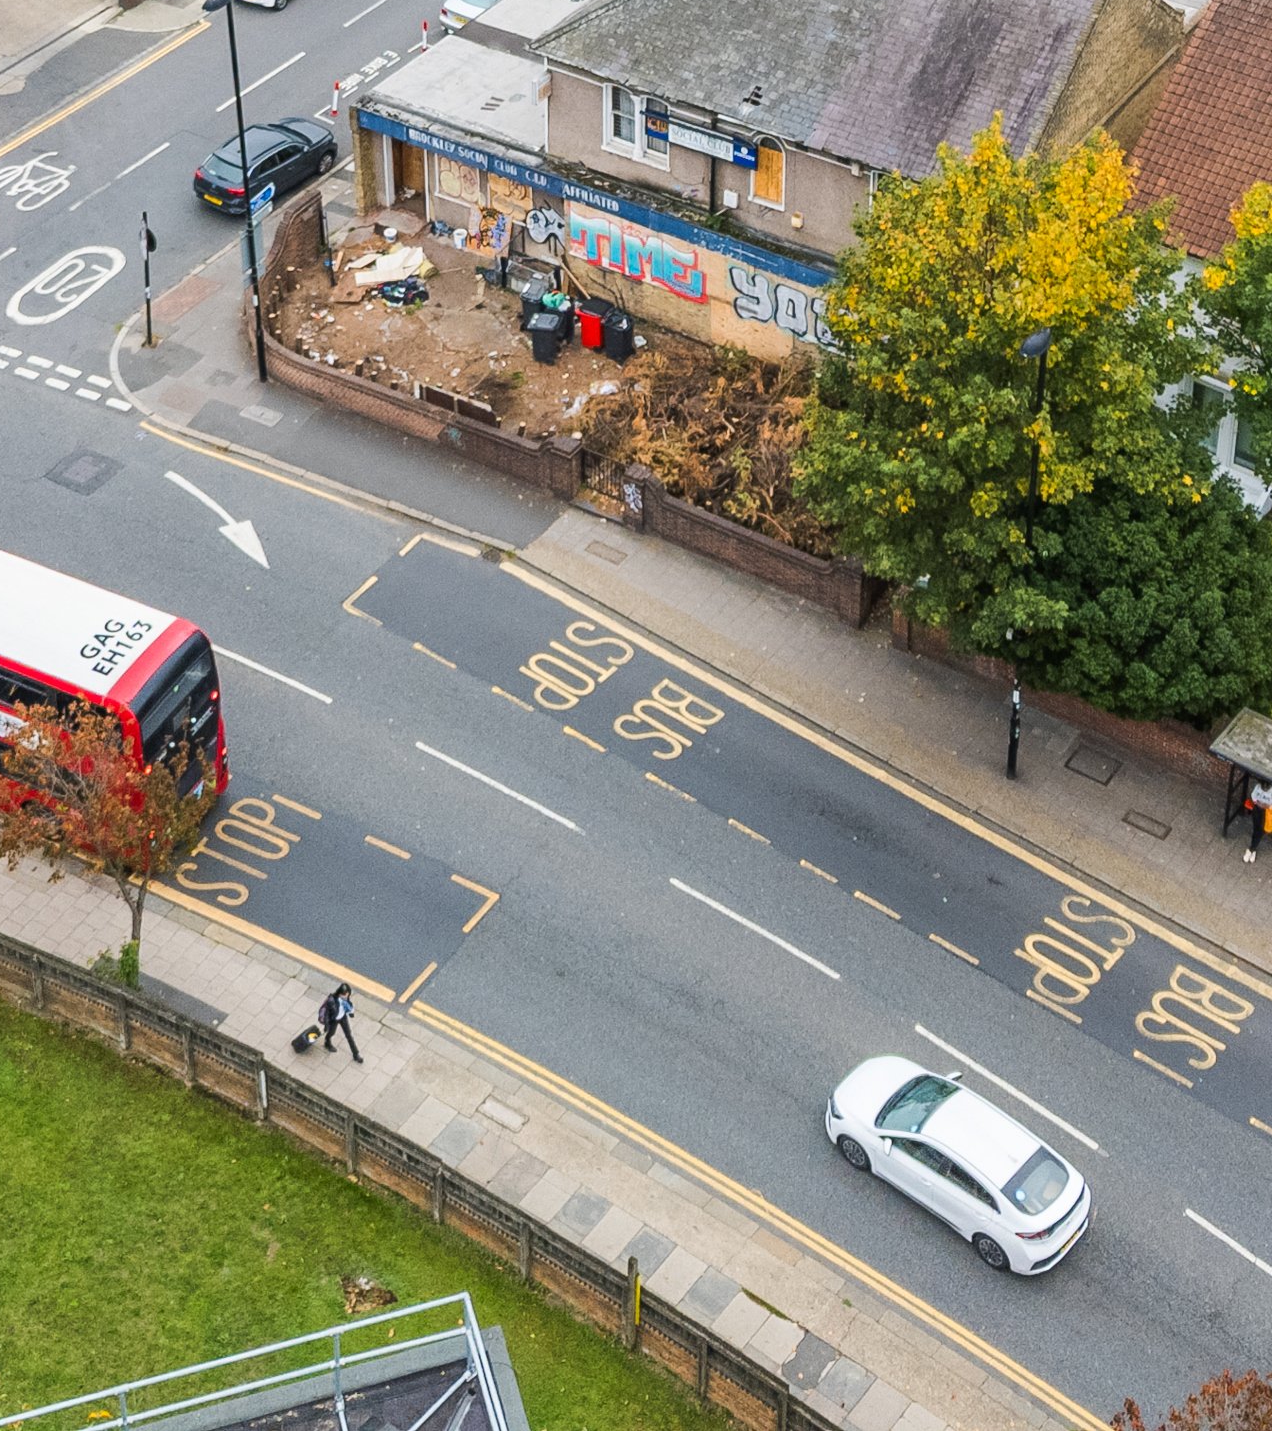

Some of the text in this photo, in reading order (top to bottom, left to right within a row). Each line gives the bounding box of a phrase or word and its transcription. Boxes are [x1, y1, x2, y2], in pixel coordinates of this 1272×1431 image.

[408, 128, 456, 156] BROCKLEY
[457, 146, 488, 171] SOCIAL
[494, 159, 518, 177] CLUB
[562, 182, 620, 213] AFFILIATED
[671, 128, 731, 155] SOCIAL CLUB
[34, 258, 110, 304] 20
[569, 210, 709, 305] TIME
[79, 619, 125, 660] GAG
[91, 620, 153, 677] EH163
[518, 621, 635, 711] STOP
[612, 678, 726, 760] BUS
[175, 797, 302, 907] STOP
[1013, 894, 1137, 1006] STOP
[1134, 965, 1256, 1070] BUS
